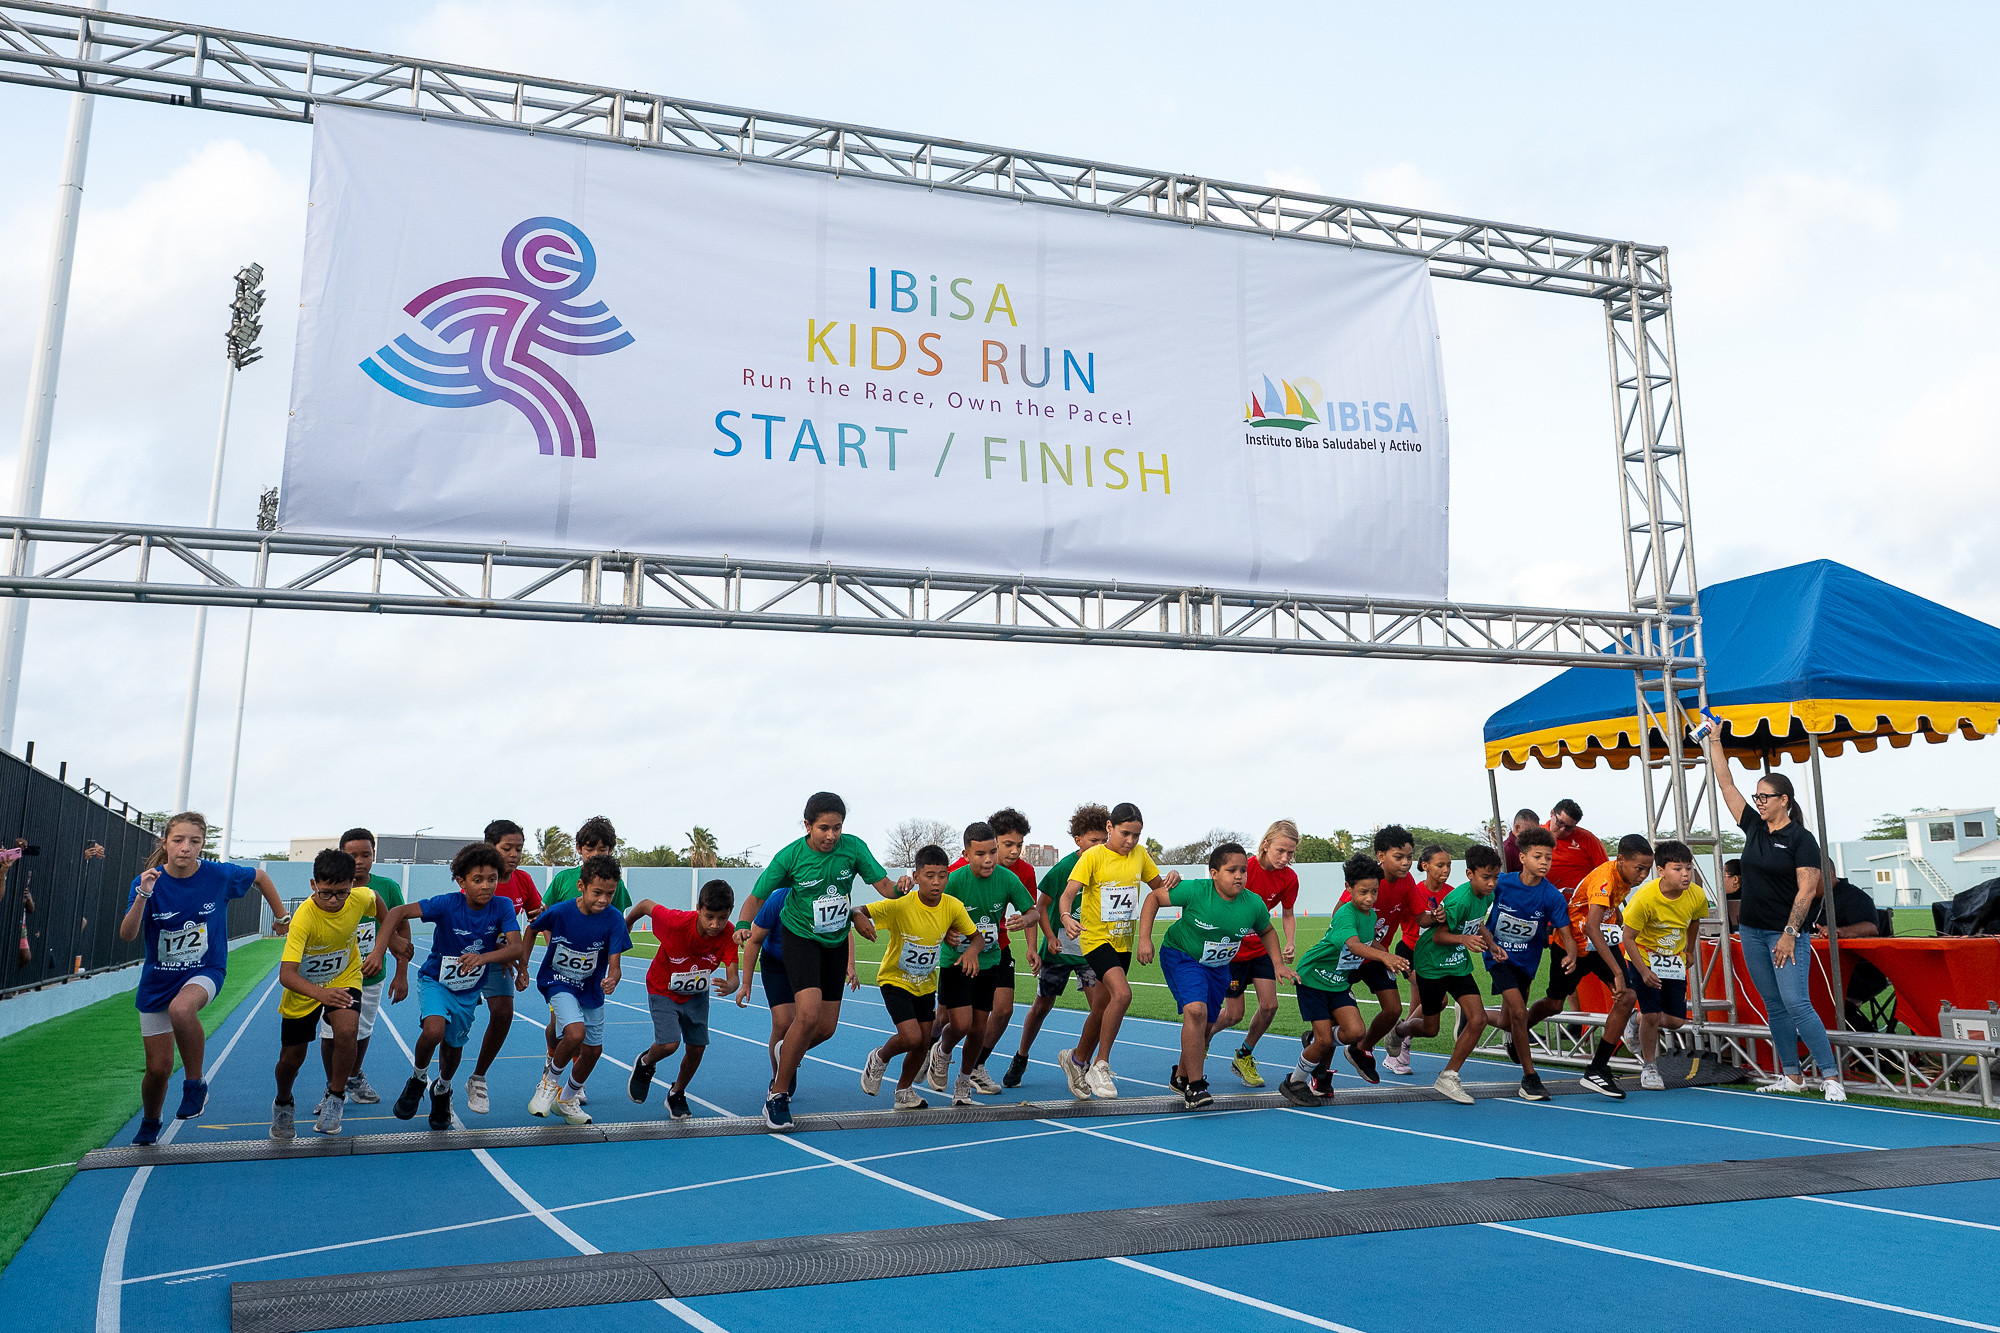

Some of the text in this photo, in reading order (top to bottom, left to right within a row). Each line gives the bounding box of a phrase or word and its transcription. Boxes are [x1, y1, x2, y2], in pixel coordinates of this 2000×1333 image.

[868, 266, 1018, 327] IBiSA
[806, 318, 1096, 394] KIDS RUN
[742, 368, 1133, 426] Run the Race, Own the Pace!
[1326, 400, 1419, 434] IBiSA
[712, 409, 1171, 495] START / FINISH
[1245, 433, 1422, 453] Instituto Biba Saludabel y Activo
[1110, 893, 1132, 910] 74
[818, 902, 848, 923] 174
[1499, 920, 1533, 937] 252
[163, 931, 201, 953] 172
[556, 952, 594, 971] 265
[905, 949, 936, 965] 261
[1205, 946, 1238, 961] 266
[1652, 954, 1682, 969] 254
[306, 956, 343, 973] 251
[673, 977, 708, 992] 260
